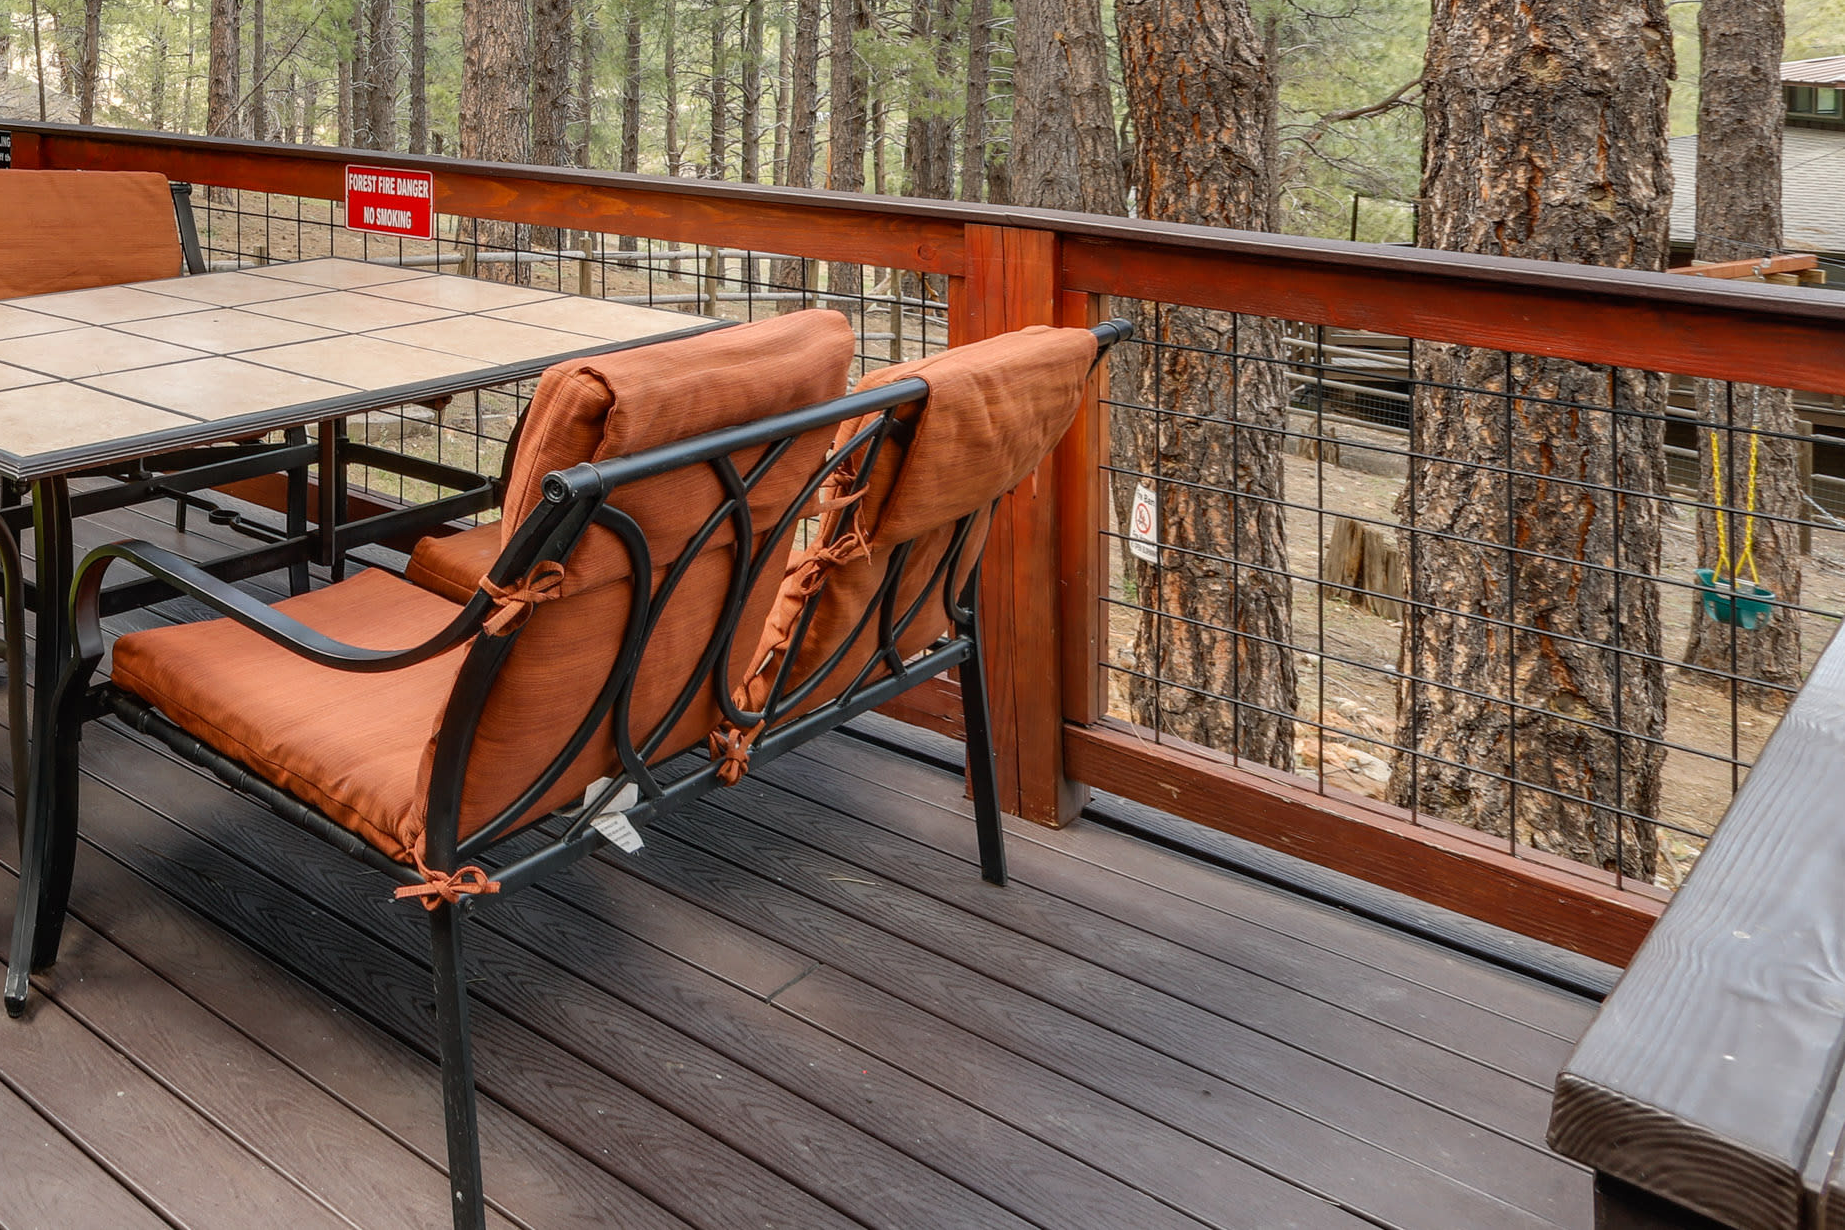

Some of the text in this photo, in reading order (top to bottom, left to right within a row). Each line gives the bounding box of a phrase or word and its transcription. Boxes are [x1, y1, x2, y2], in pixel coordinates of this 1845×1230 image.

[349, 173, 429, 199] FOREST FIRE DANGER
[363, 206, 412, 230] NO SMOKING
